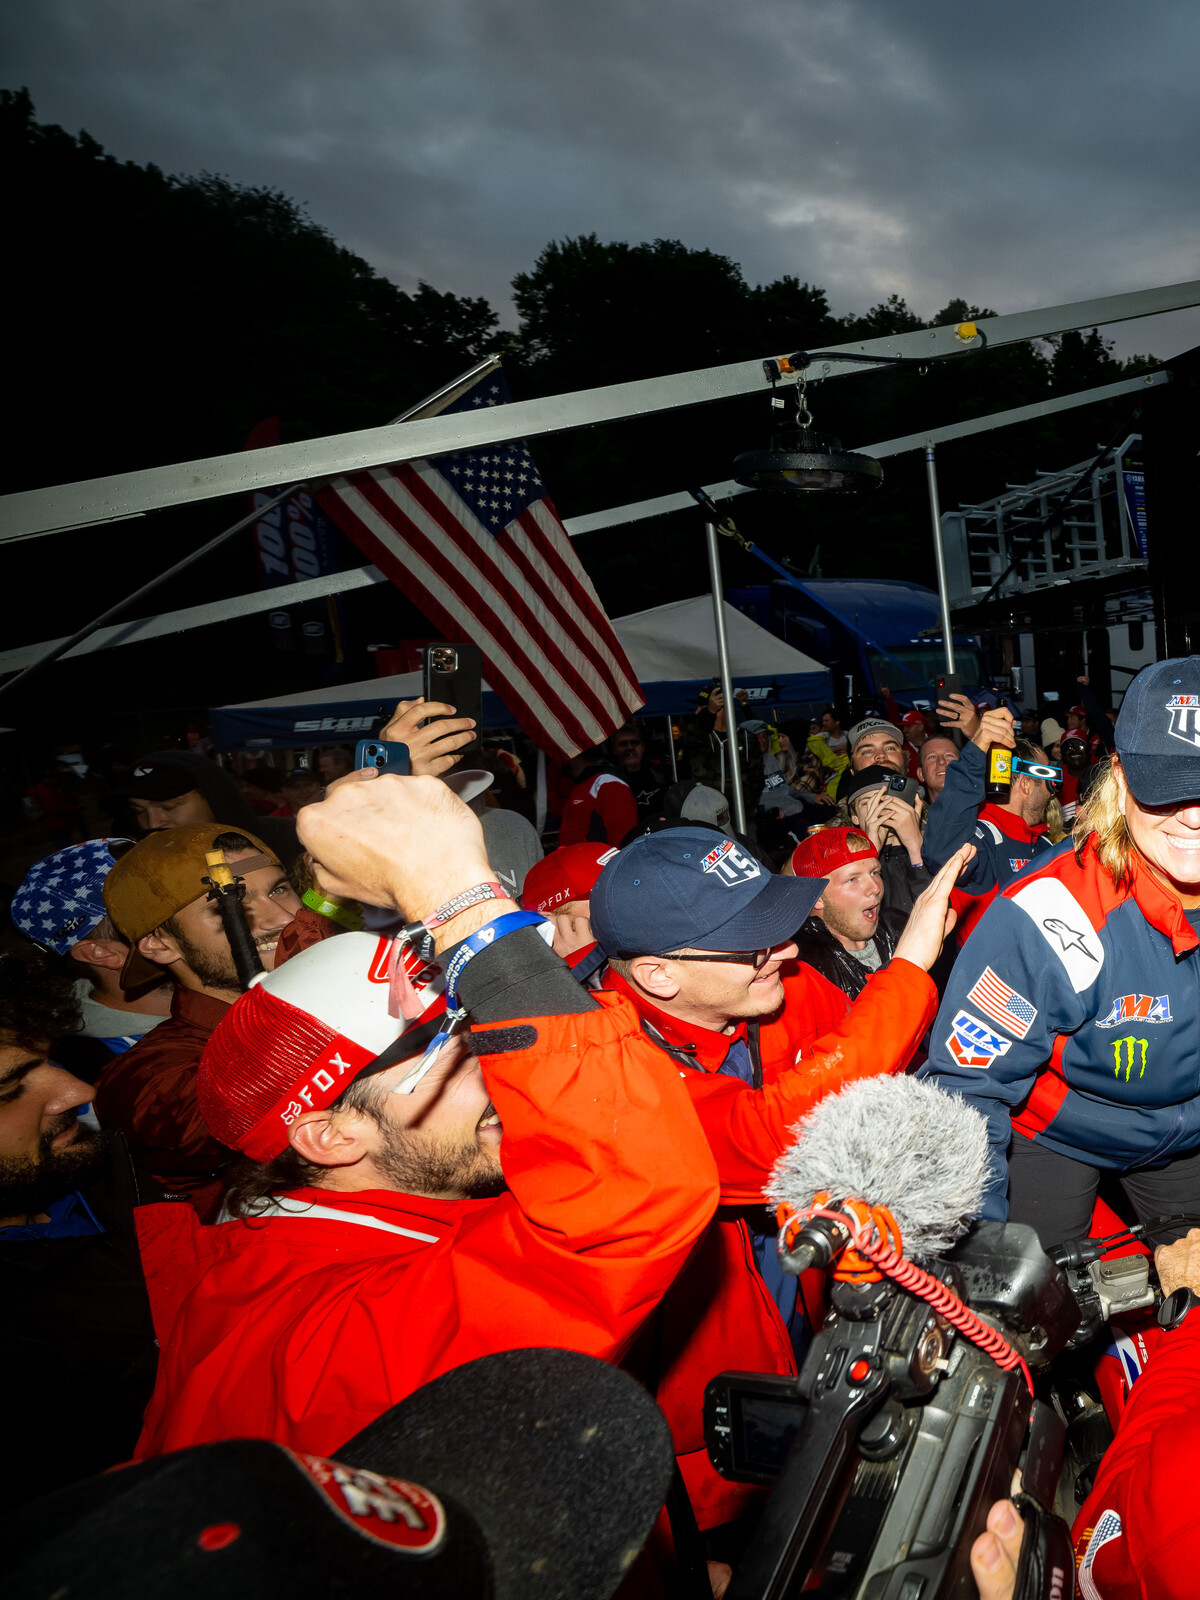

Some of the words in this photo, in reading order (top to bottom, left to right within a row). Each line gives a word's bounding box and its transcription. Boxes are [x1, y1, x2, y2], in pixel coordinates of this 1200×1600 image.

[1167, 695, 1199, 706] AMA
[702, 842, 729, 871] AMA
[704, 844, 761, 887] US
[436, 883, 491, 914] Saturday
[437, 890, 497, 922] Mechanic
[548, 887, 571, 907] FOX
[477, 927, 496, 944] 4
[447, 949, 476, 998] Mechanic
[1097, 994, 1172, 1026] AMA
[955, 1015, 1010, 1051] MX
[298, 1052, 351, 1108] FOX
